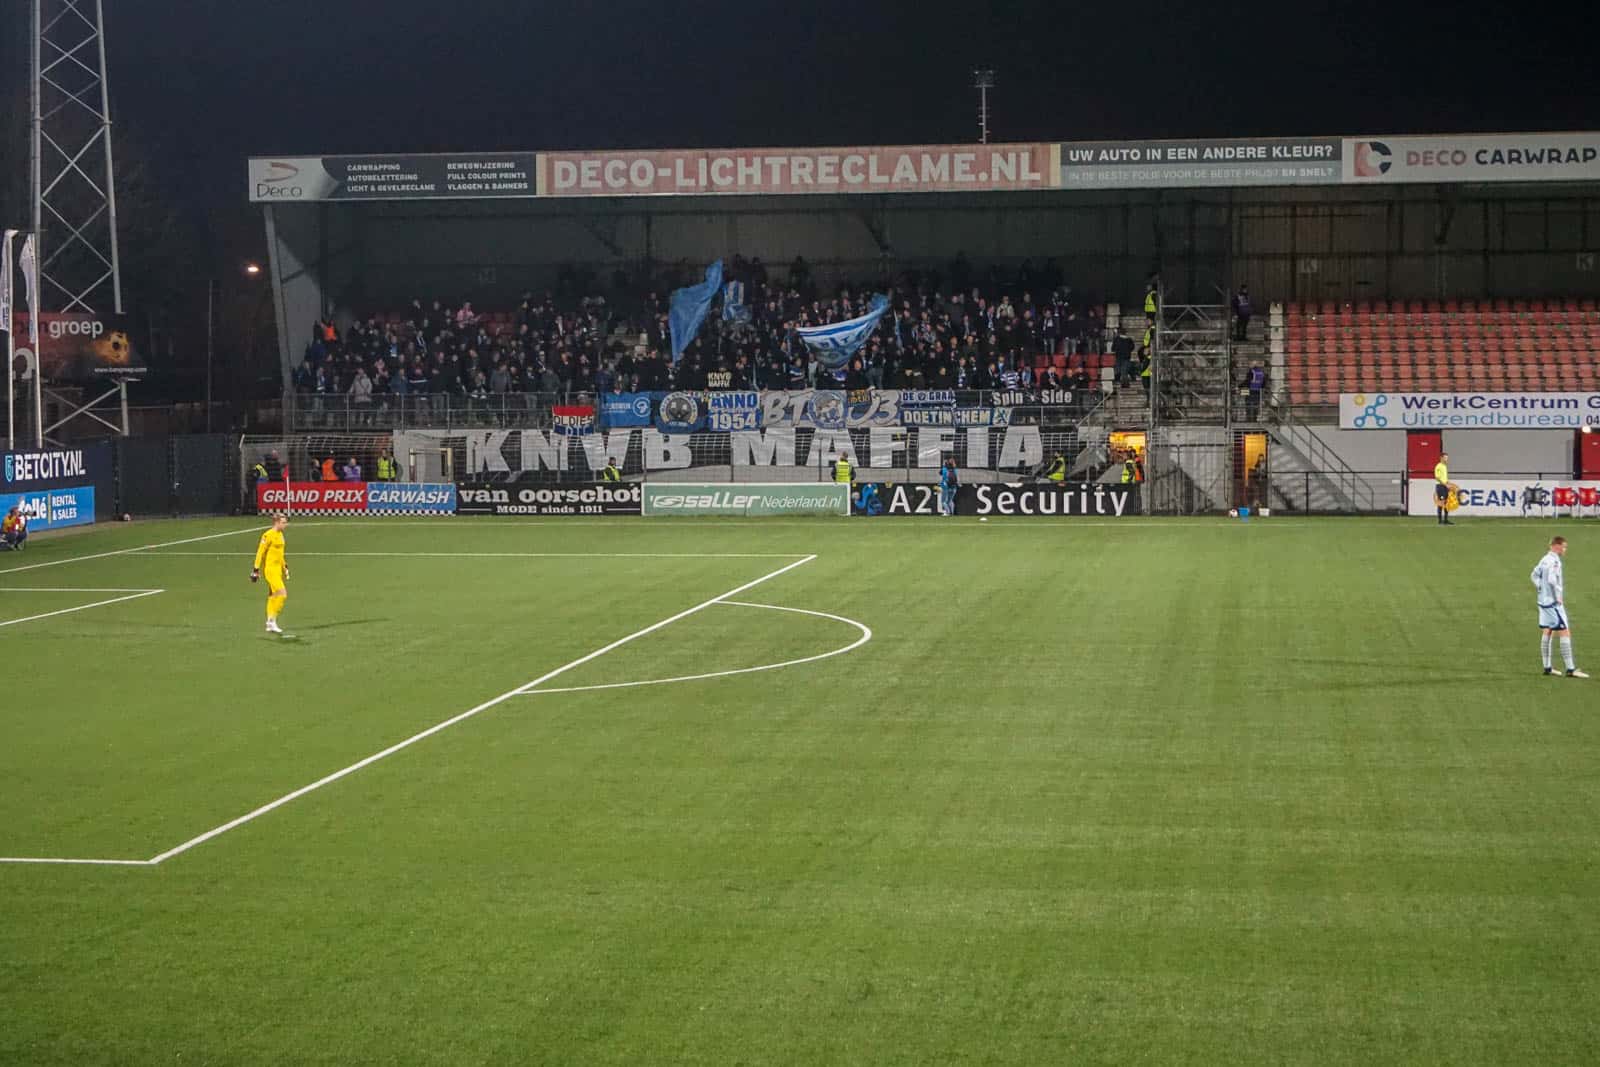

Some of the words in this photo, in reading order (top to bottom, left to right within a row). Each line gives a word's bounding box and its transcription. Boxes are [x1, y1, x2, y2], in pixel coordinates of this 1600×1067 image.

[1070, 150, 1093, 161] UW
[1099, 149, 1141, 160] AUTO
[1146, 149, 1161, 160] IN
[1167, 148, 1198, 160] EEN
[1203, 146, 1267, 159] ANDERE
[1272, 145, 1333, 158] KLEUR?
[1406, 150, 1466, 166] DECO
[1475, 148, 1597, 165] CARWRAP
[554, 152, 1041, 188] DECO-LICHTRECLAME.NL
[256, 183, 302, 198] Deco
[448, 183, 483, 191] VLAGGEN
[492, 182, 528, 190] BANNERS
[49, 320, 104, 339] groep
[711, 393, 757, 408] ANNO
[1402, 395, 1579, 409] WerkCentrum
[711, 411, 757, 430] 1954
[904, 410, 991, 425] DOETINCHEM
[1402, 412, 1581, 426] Uitzendbureau
[466, 429, 693, 471] KNVB
[732, 426, 1044, 468] MAFFIA
[52, 494, 77, 507] RENTAL
[263, 490, 319, 503] GRAND
[323, 490, 365, 502] PRIX
[367, 490, 450, 503] CARWASH
[459, 488, 510, 503] van
[518, 486, 641, 503] oorschot
[760, 496, 842, 508] Nederland.nl
[976, 484, 1129, 516] Security
[1457, 489, 1516, 507] CEAN
[58, 508, 77, 519] SALES
[497, 505, 537, 513] MODE
[541, 505, 575, 513] sinds
[580, 505, 603, 513] 1911
